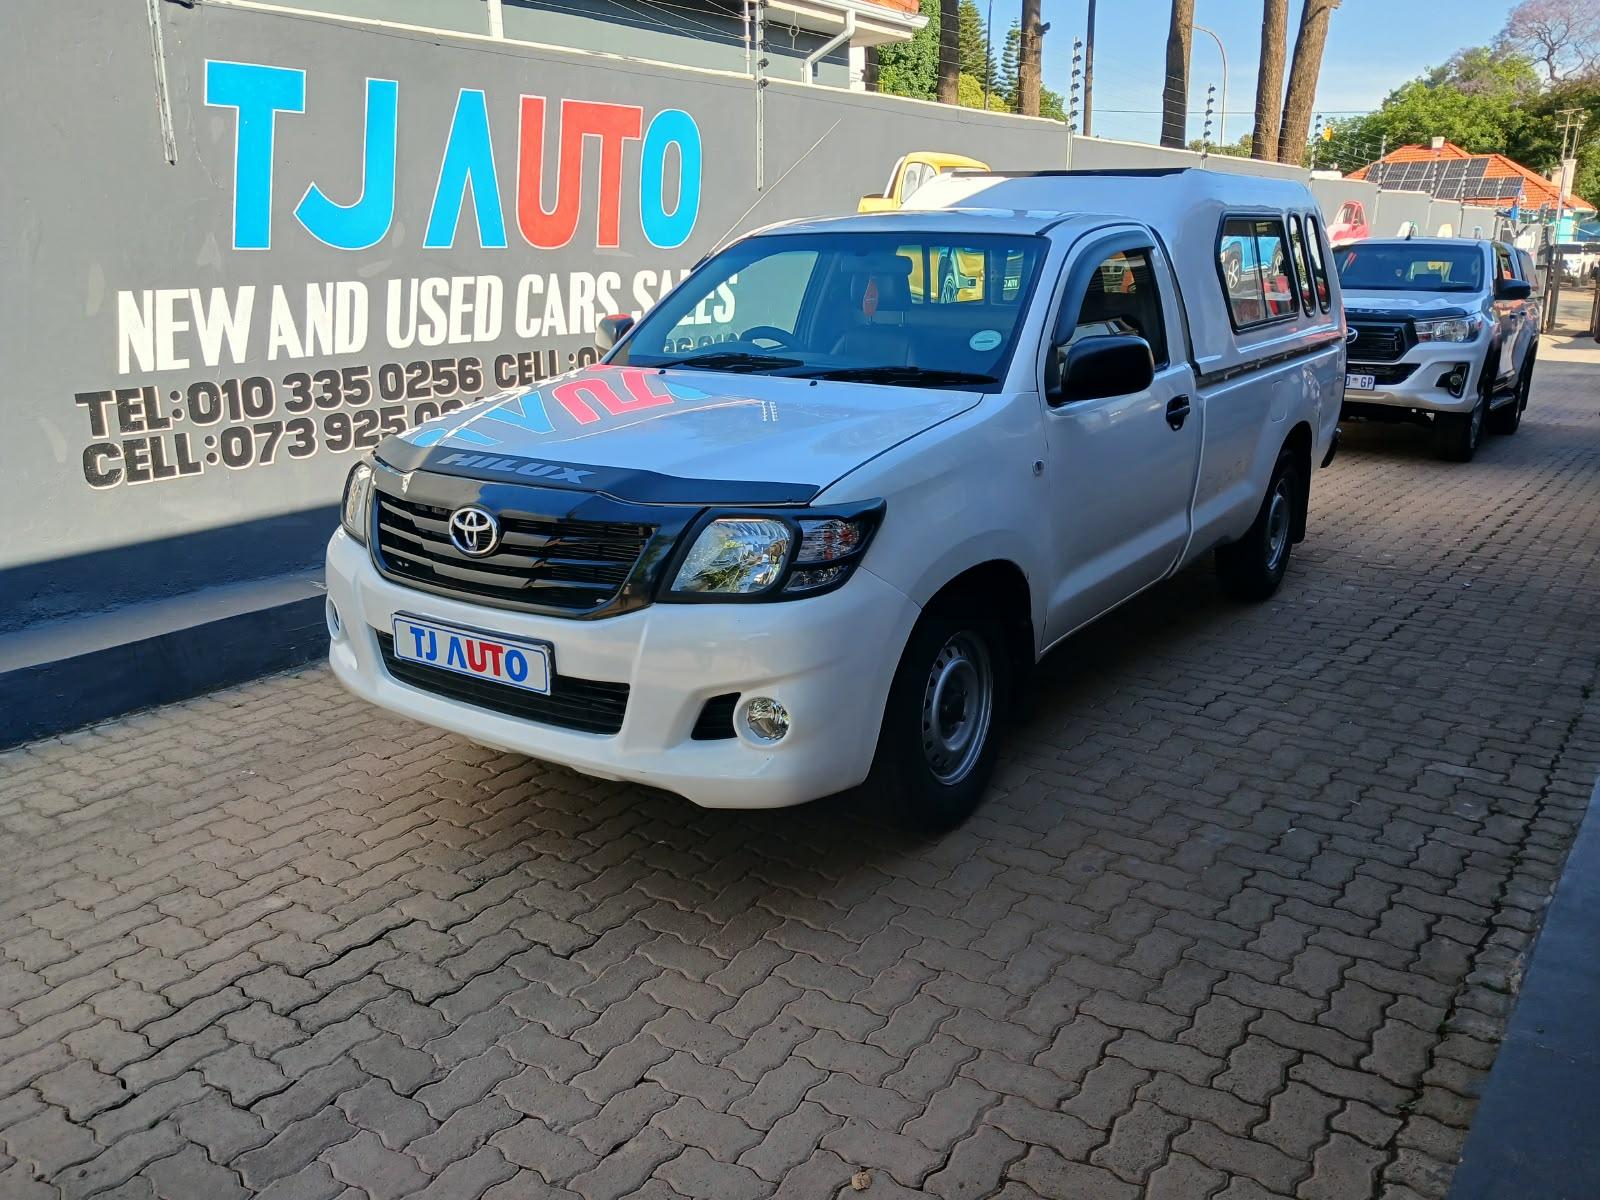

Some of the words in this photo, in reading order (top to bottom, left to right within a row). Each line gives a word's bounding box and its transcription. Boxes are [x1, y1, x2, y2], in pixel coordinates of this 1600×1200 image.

[204, 59, 398, 251] TJ
[423, 88, 701, 249] AUTO
[117, 285, 256, 374] NEW
[268, 280, 368, 361] AND
[386, 275, 501, 349] USED
[515, 271, 621, 338] CARS
[74, 376, 276, 439] TEL:010
[282, 363, 372, 414] 335
[378, 356, 483, 402] 0256
[1360, 376, 1374, 388] GP
[82, 416, 319, 490] CELL:073
[323, 404, 408, 454] 925
[436, 453, 597, 484] HILUX
[410, 626, 437, 661] TJ
[447, 636, 528, 682] AUTO
